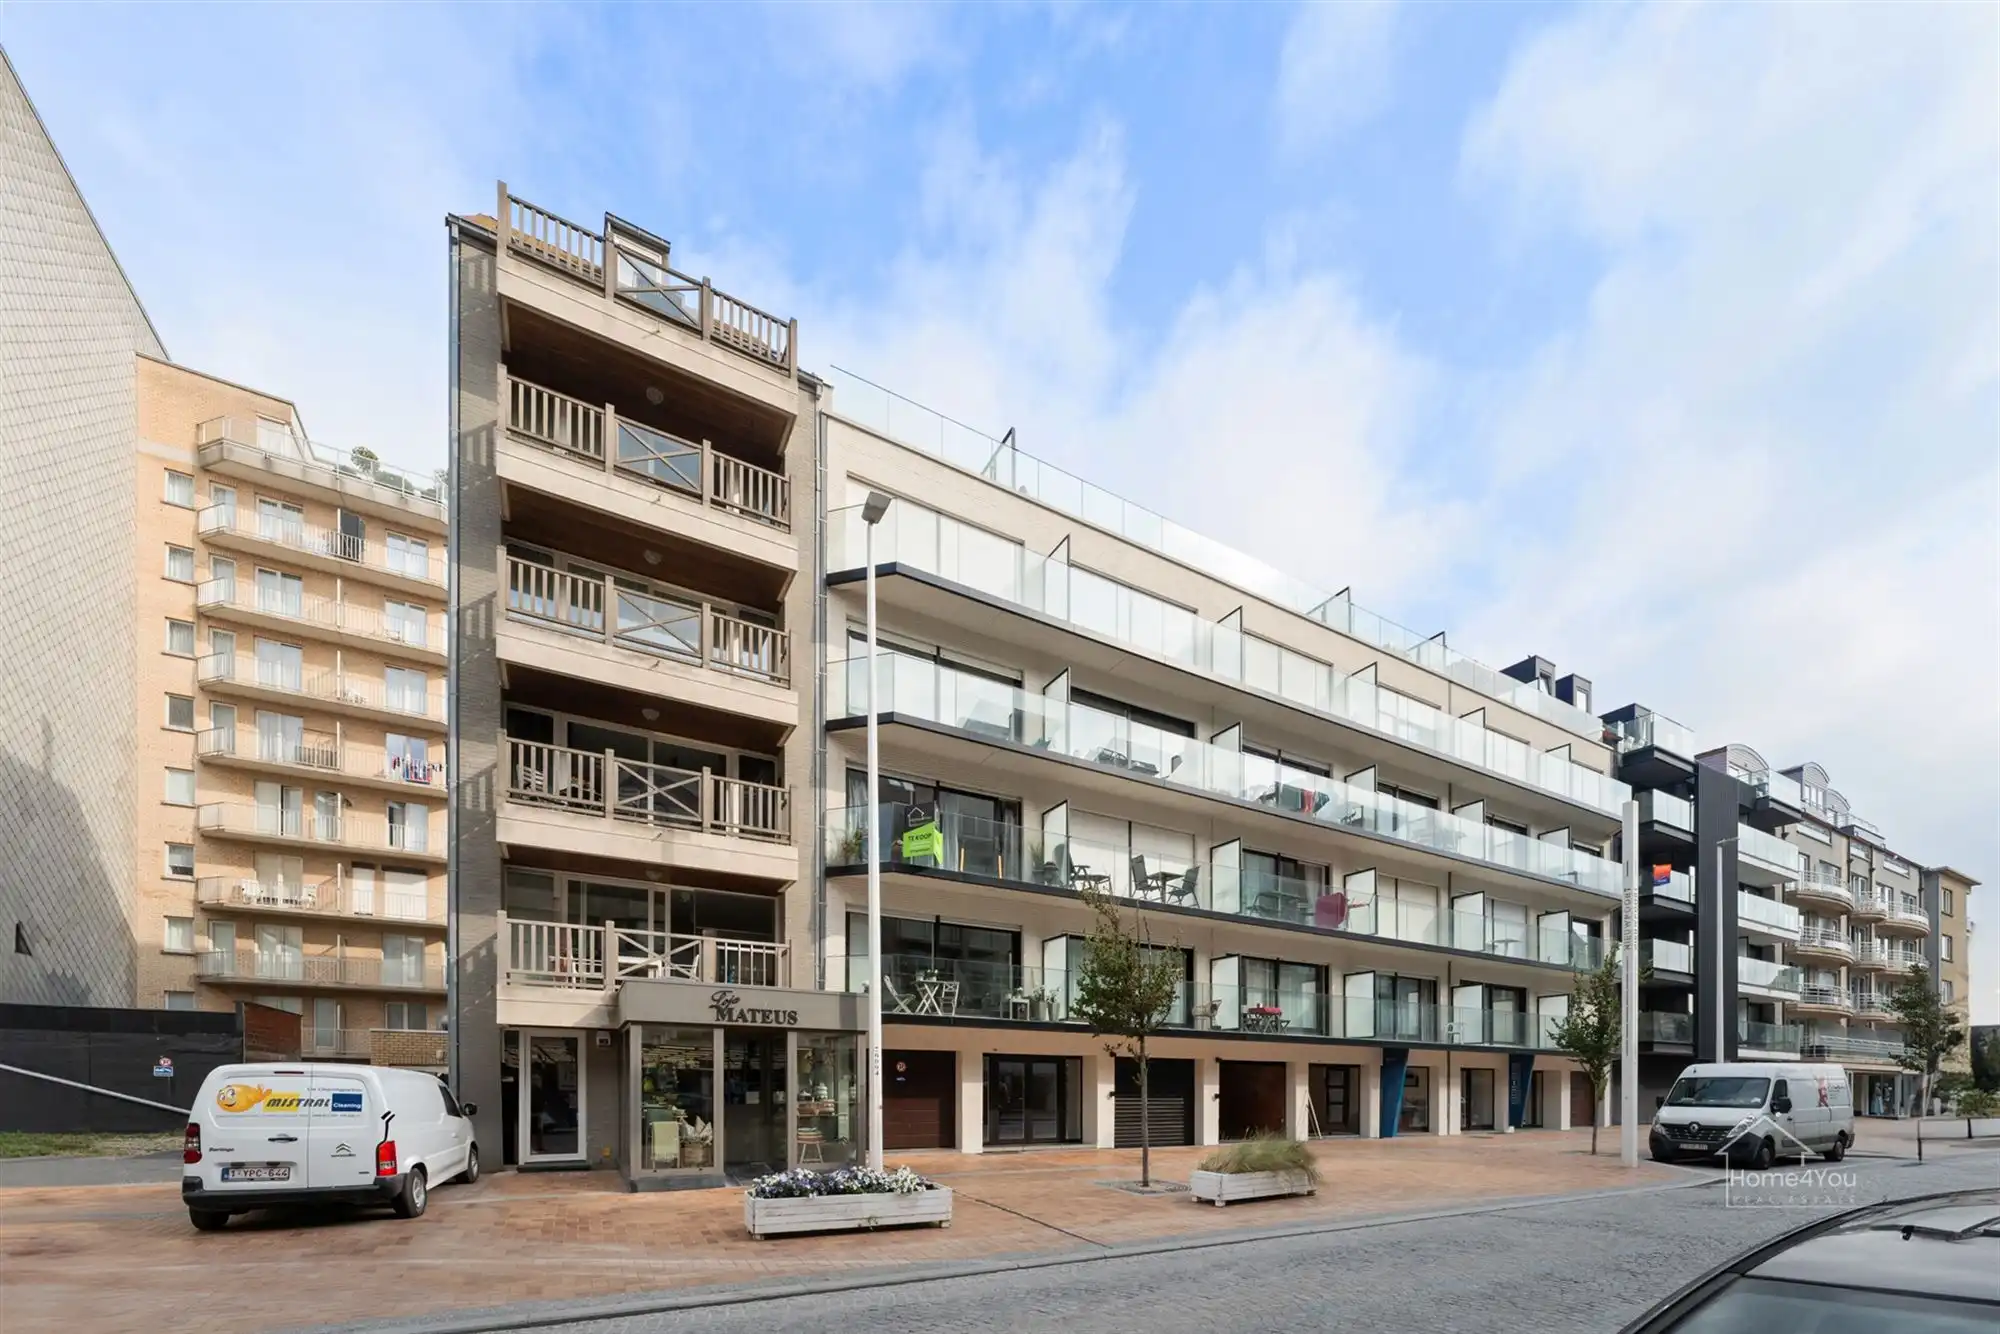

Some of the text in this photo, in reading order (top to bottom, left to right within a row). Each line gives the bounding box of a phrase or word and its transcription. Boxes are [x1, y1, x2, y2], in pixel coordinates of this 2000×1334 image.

[1623, 888, 1632, 950] NIEUWPOORT
[709, 1004, 799, 1026] MATEUS
[267, 1098, 331, 1108] MISTRAL
[231, 1168, 288, 1177] 1-YPC-644
